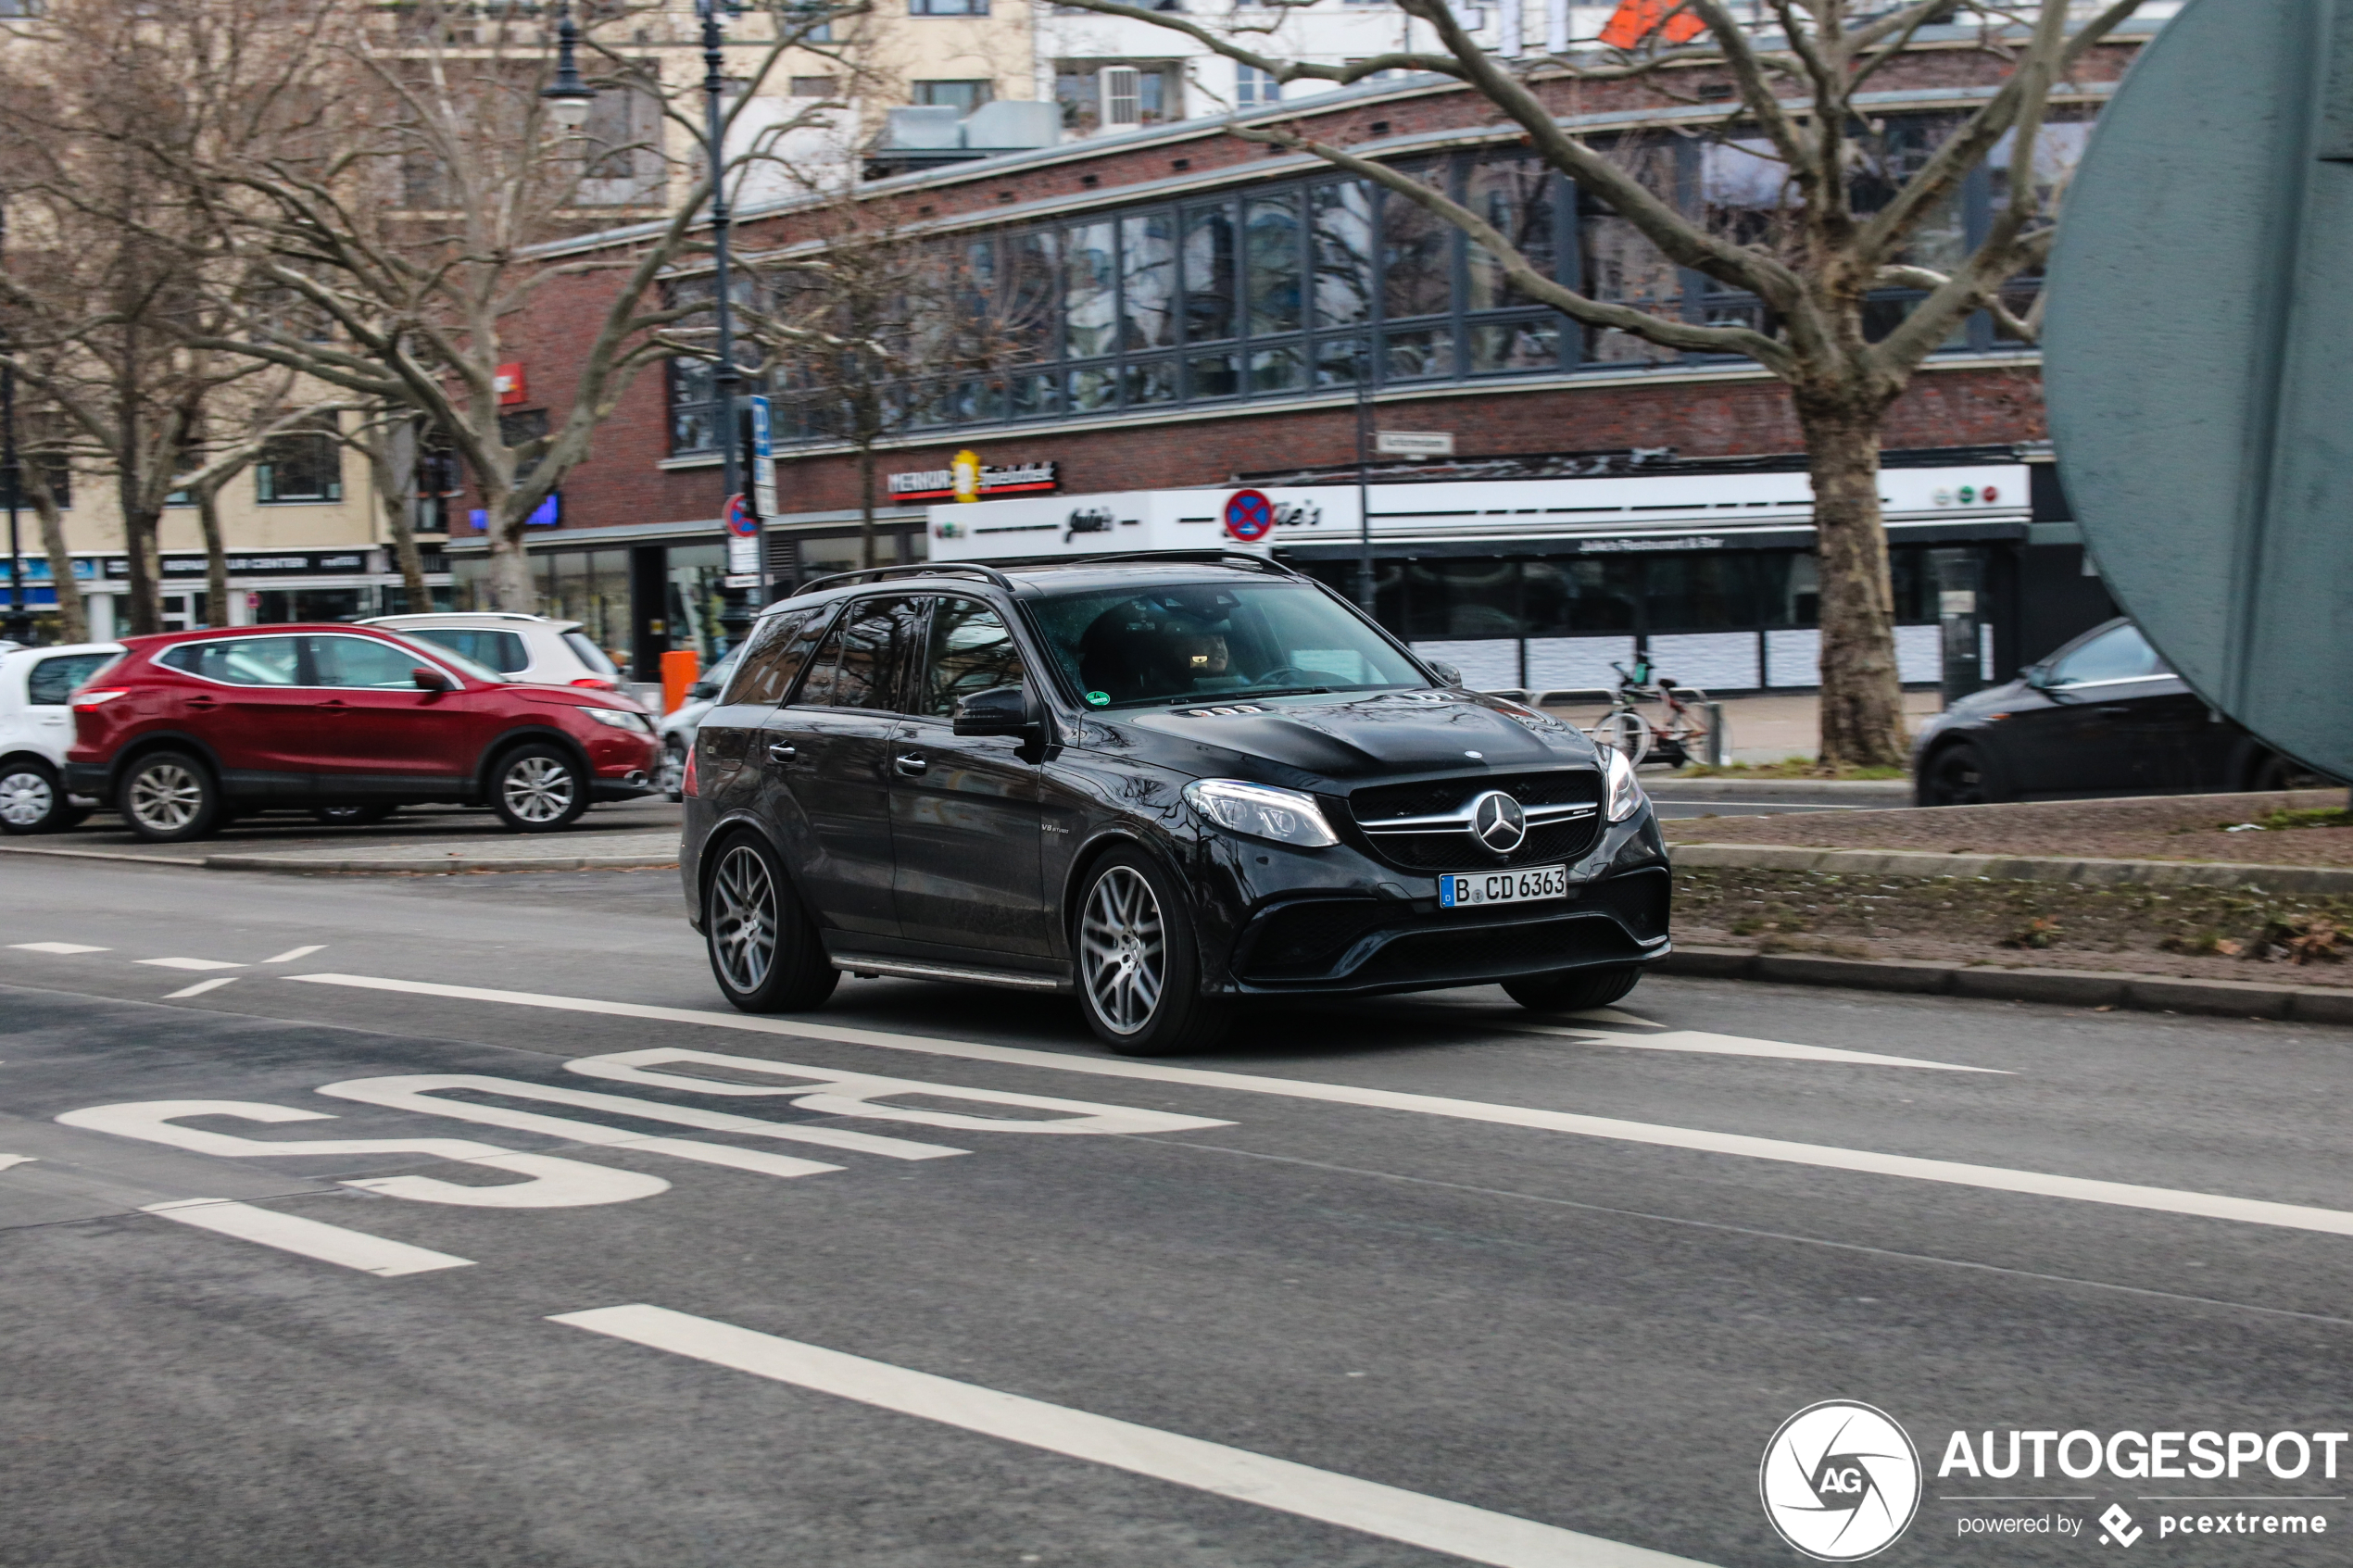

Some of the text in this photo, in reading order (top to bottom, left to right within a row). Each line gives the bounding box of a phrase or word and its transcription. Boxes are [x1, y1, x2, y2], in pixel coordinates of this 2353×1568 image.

[887, 470, 952, 492] MERKUR
[252, 557, 308, 569] CENTER
[1041, 823, 1052, 832] V8
[1455, 871, 1565, 902] B CD 6363
[1445, 894, 1451, 902] D
[54, 1047, 1239, 1210] BUS
